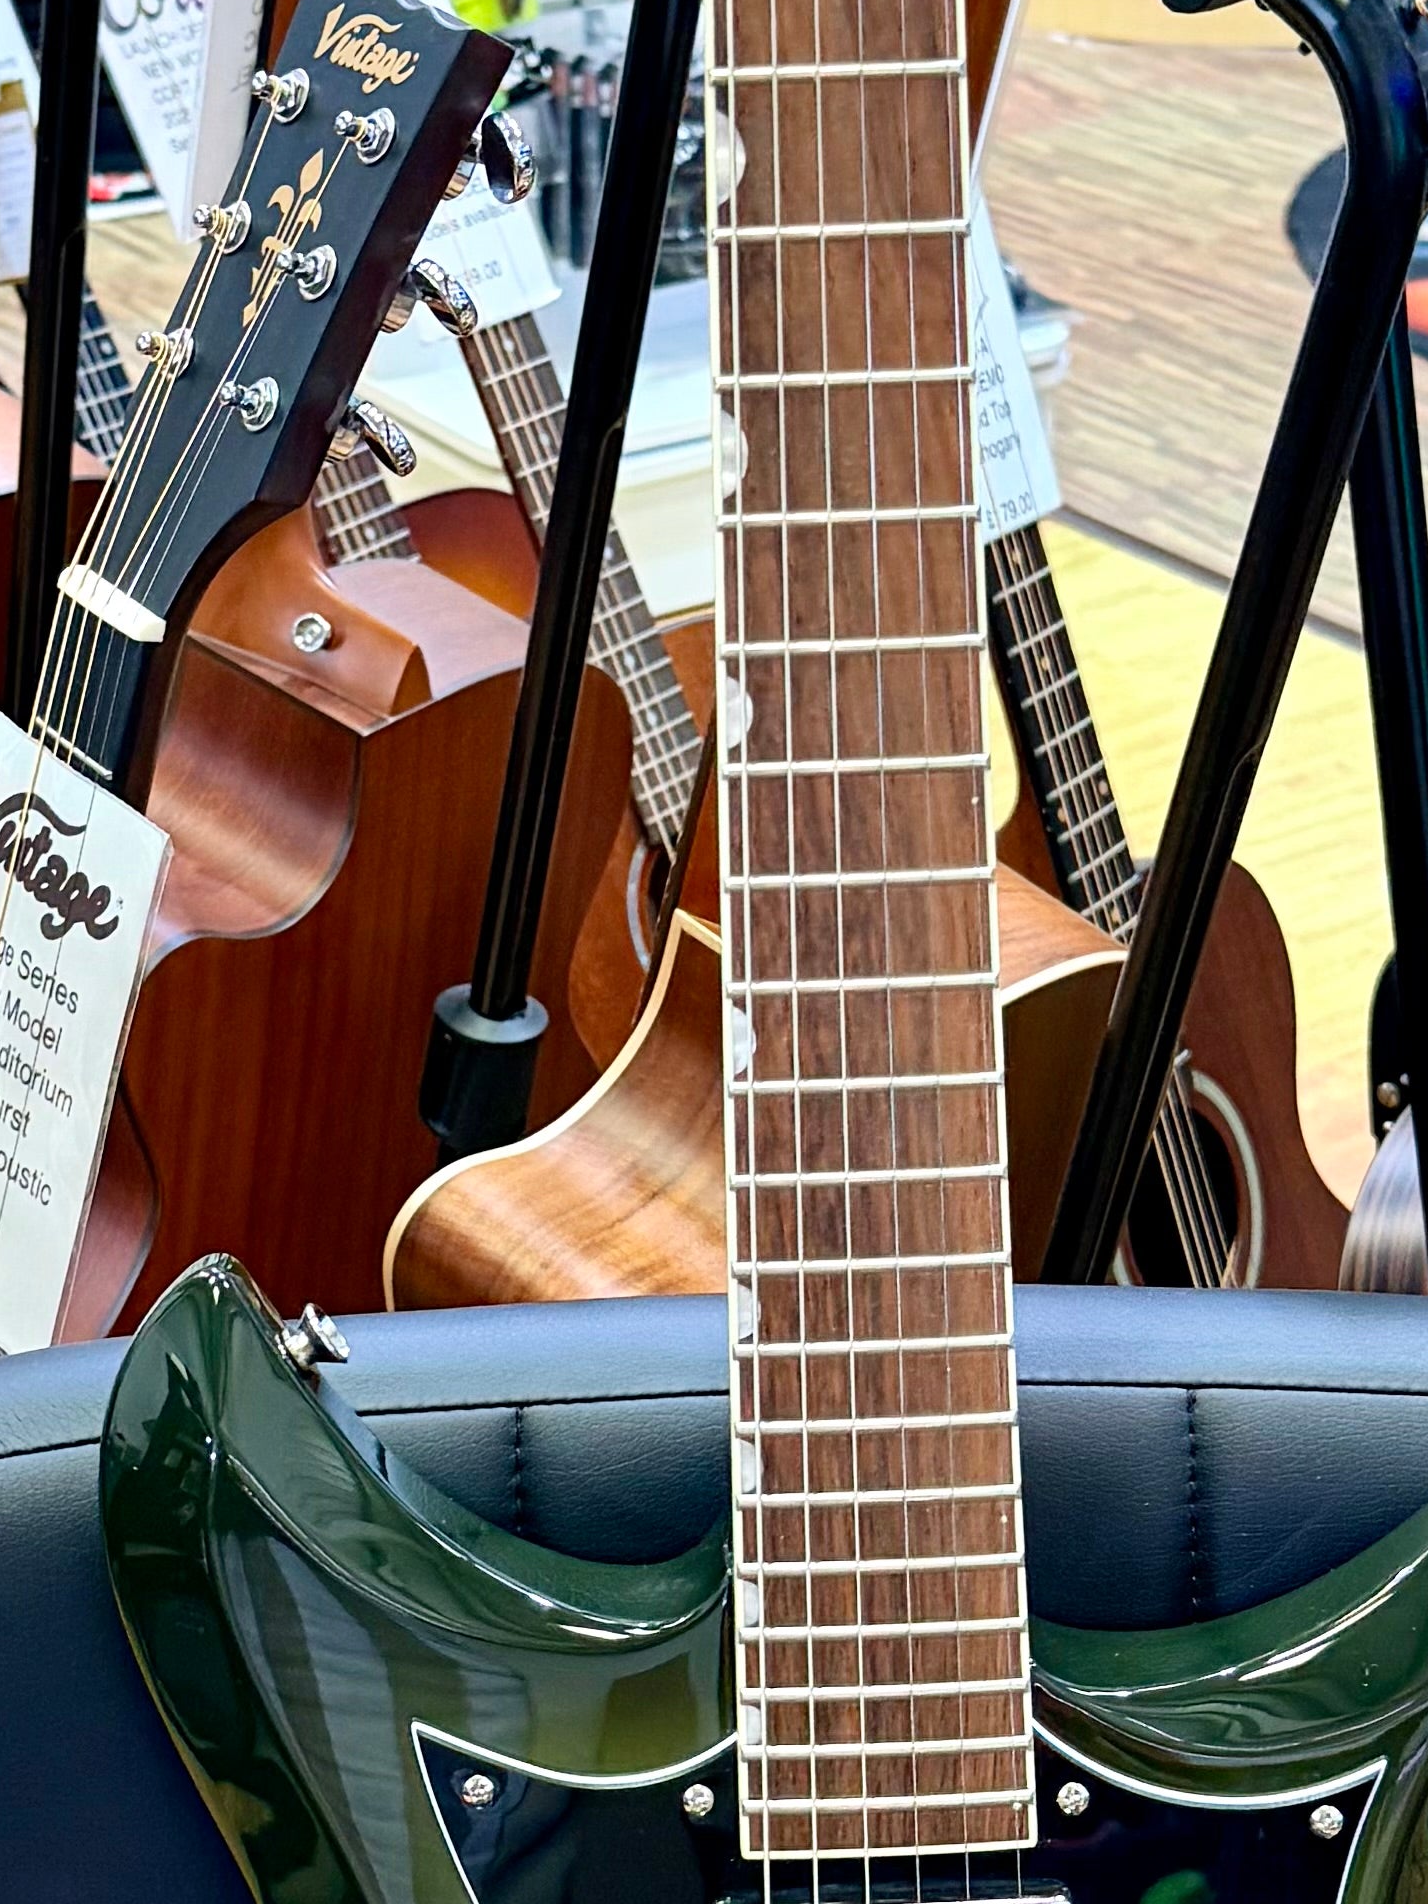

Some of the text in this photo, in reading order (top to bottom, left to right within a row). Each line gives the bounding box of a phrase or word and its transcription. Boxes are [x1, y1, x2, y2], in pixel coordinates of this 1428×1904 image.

[313, 2, 420, 95] Vintage
[16, 949, 79, 1015] Series
[2, 989, 63, 1055] Model
